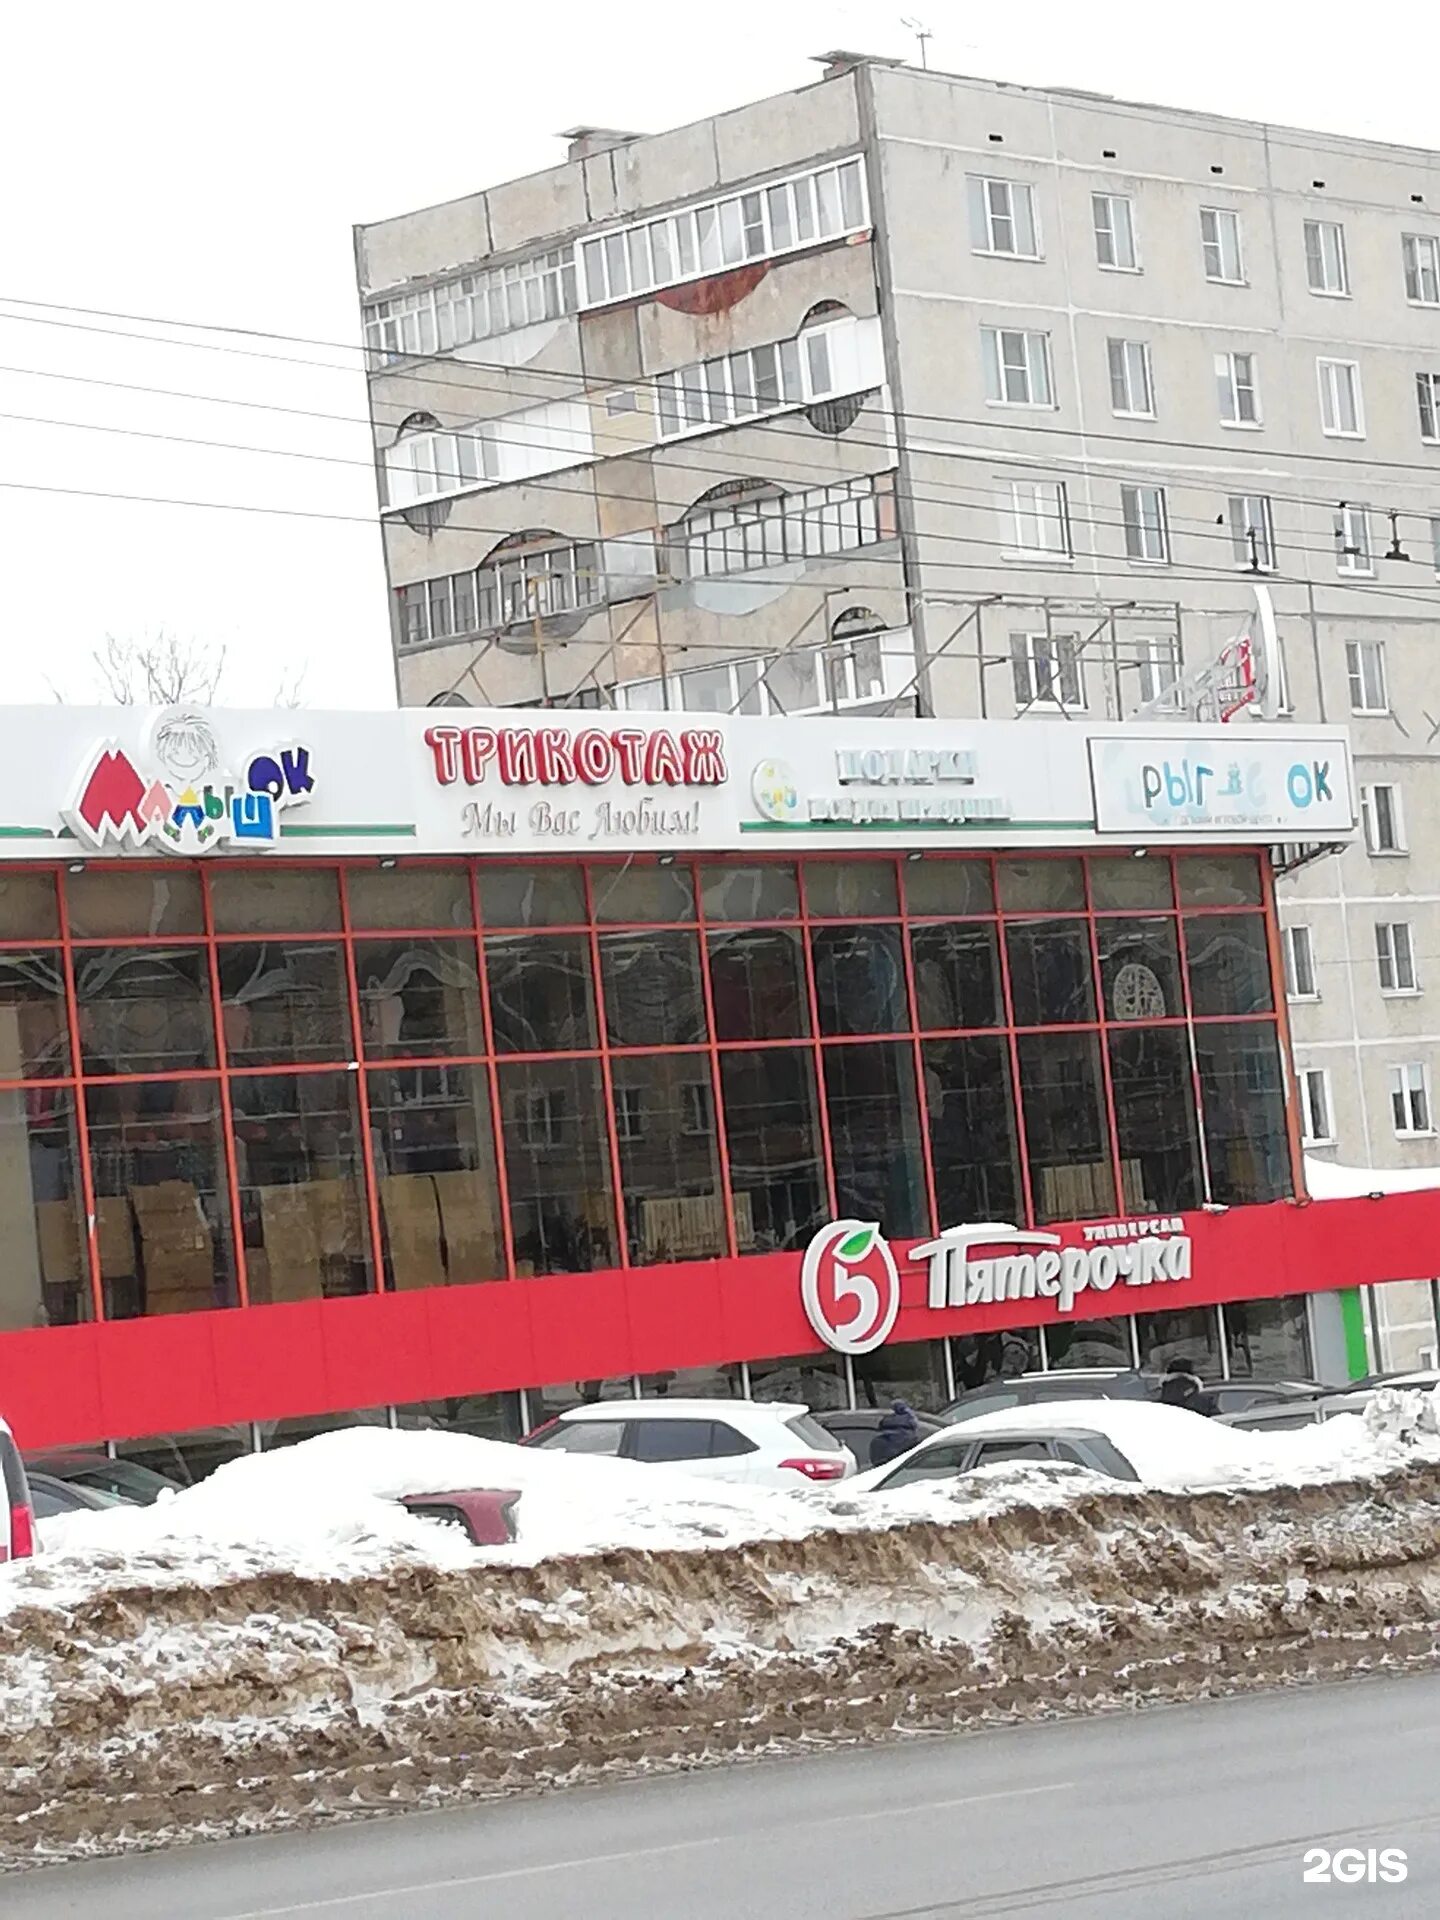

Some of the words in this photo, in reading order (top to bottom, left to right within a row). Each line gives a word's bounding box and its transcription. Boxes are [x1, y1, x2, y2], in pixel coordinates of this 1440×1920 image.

[424, 727, 728, 786] ТРИКОТАЖ
[462, 801, 516, 838] Мы
[529, 800, 581, 836] Вас
[588, 797, 700, 841] Любим!
[908, 1228, 1193, 1312] Пятерочка
